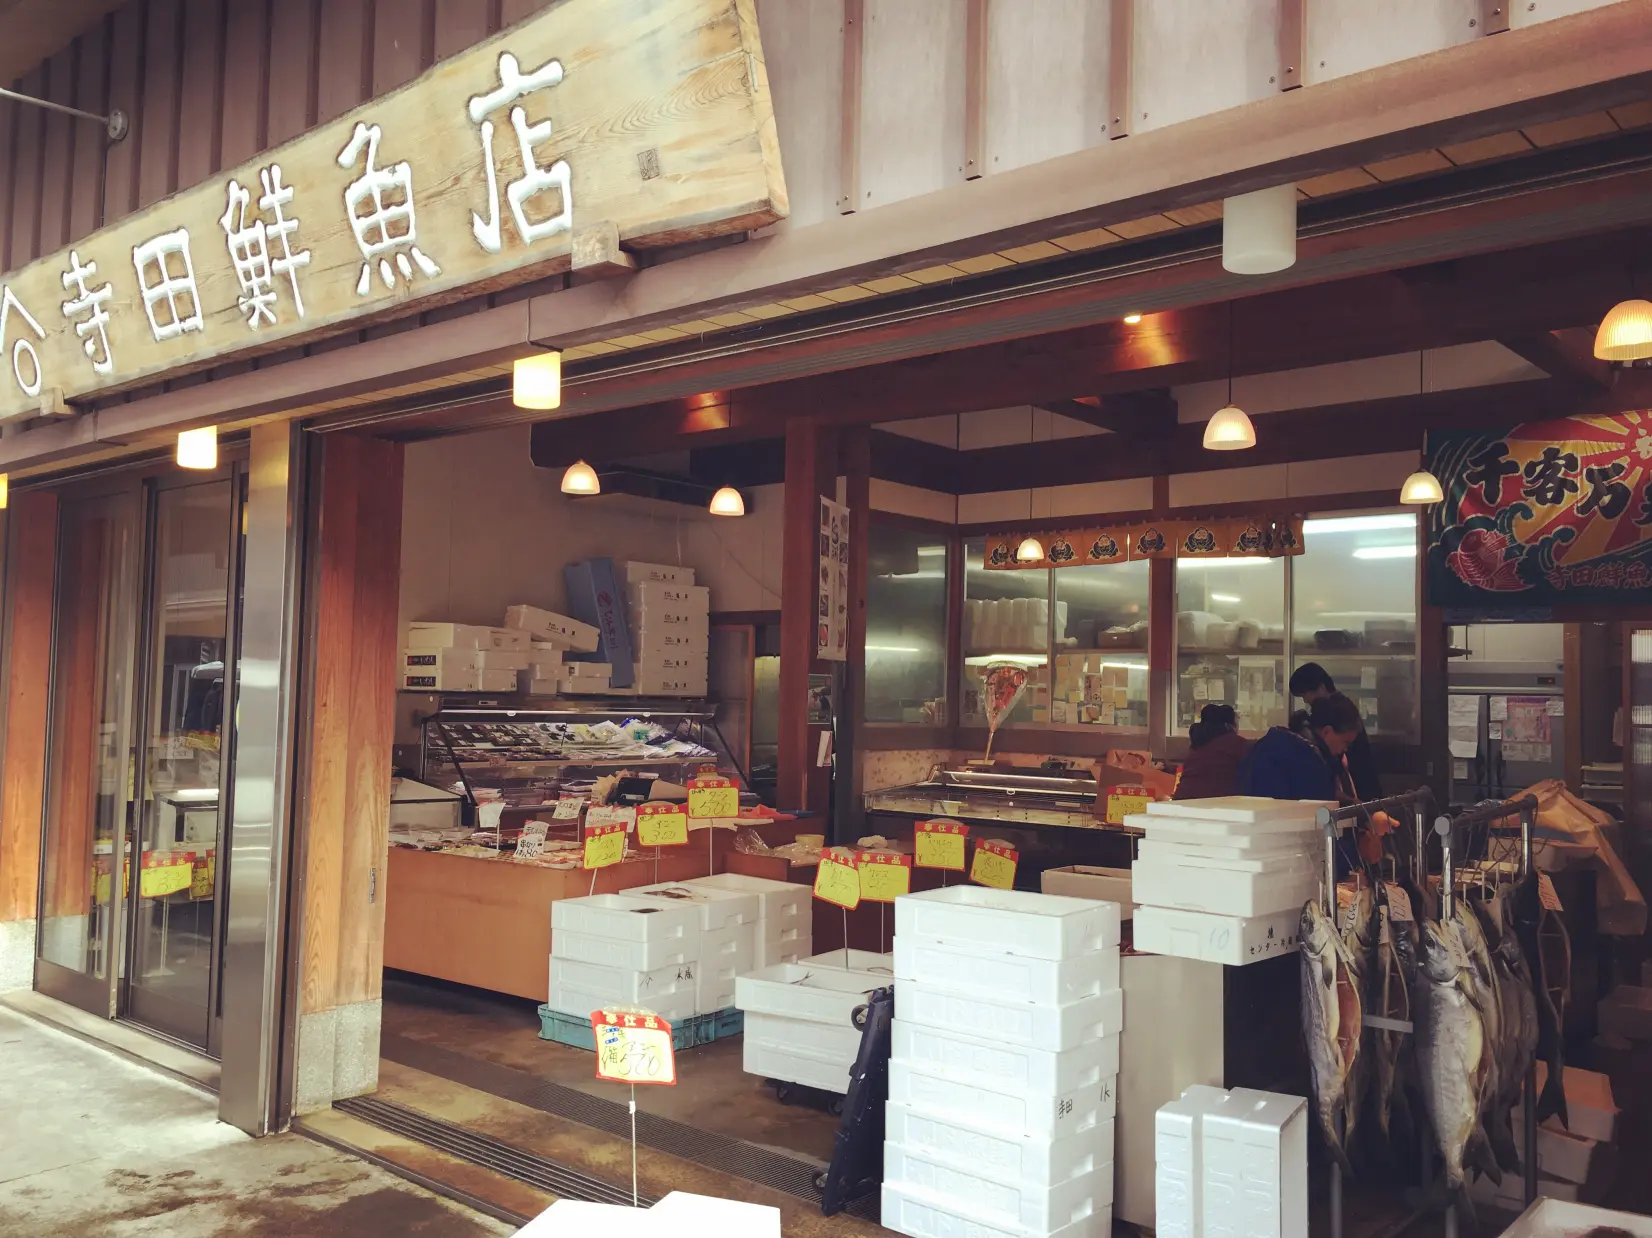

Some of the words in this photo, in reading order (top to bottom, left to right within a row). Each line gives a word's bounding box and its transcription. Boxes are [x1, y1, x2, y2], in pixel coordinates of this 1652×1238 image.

[61, 51, 575, 377] 寺田鮮魚店
[1545, 560, 1652, 590] 寺田鮮魚
[924, 823, 959, 834] 奉仕品
[862, 853, 901, 865] 奉仕品
[602, 1011, 658, 1029] 奉仕品
[1058, 1098, 1073, 1120] 寺田
